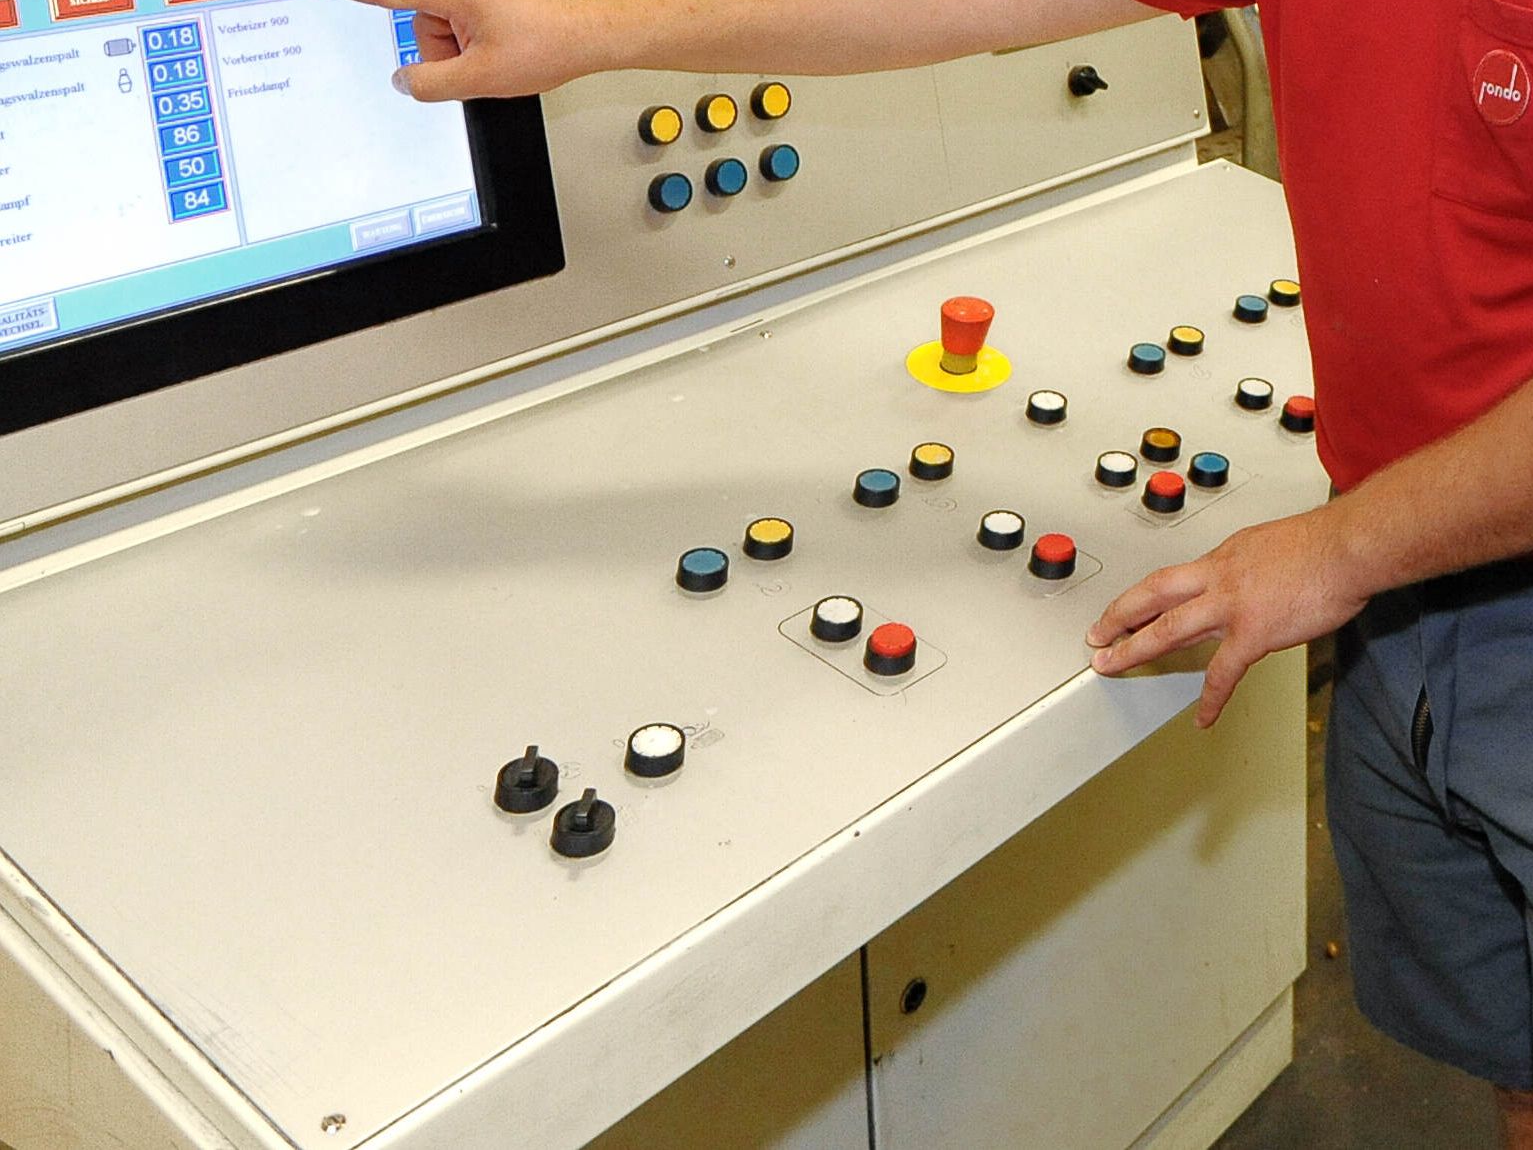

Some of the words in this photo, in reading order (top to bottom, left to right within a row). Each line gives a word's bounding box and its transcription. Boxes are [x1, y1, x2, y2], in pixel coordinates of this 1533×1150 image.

[270, 16, 290, 27] 900
[148, 27, 194, 50] 0.18
[222, 51, 282, 67] Vorbereiter
[283, 45, 302, 57] 900
[153, 60, 199, 83] 0.18
[227, 78, 291, 99] Frischdampf
[1478, 64, 1521, 105] rondo
[158, 92, 204, 115] 0.35
[173, 125, 200, 145] 86
[179, 157, 205, 178] 50
[184, 189, 211, 210] 84
